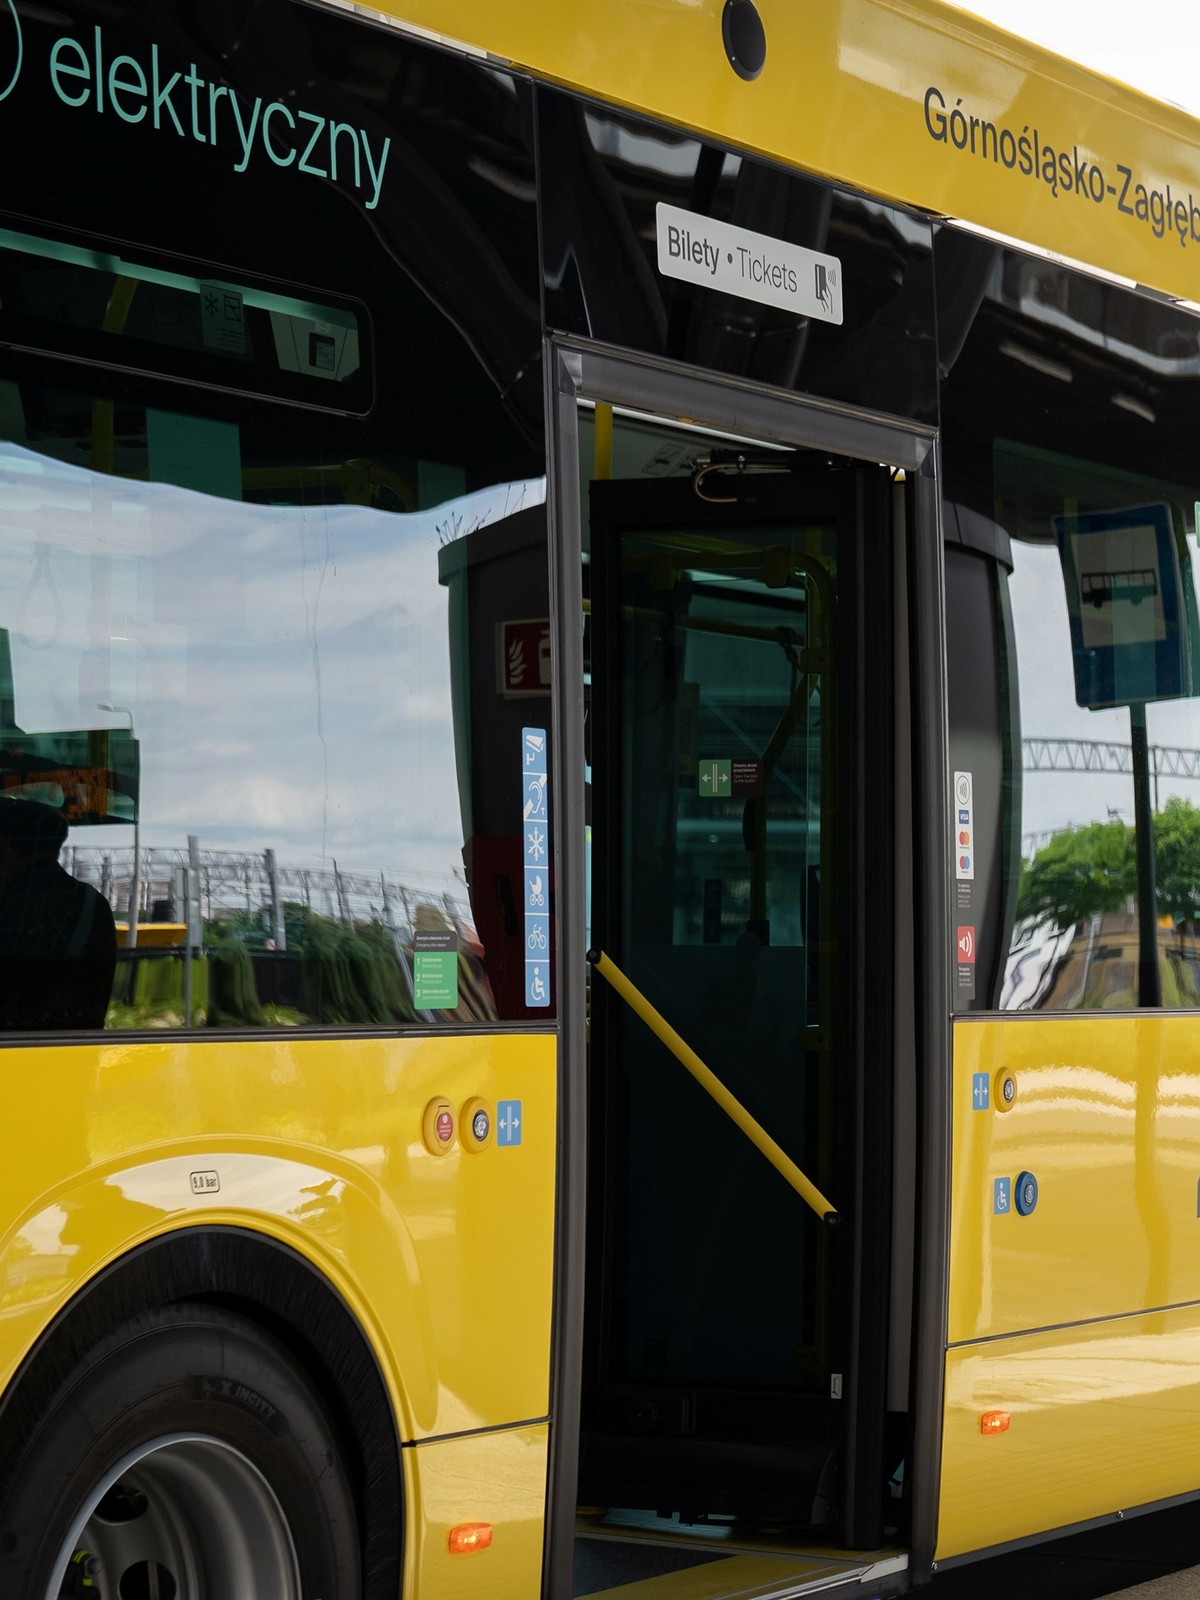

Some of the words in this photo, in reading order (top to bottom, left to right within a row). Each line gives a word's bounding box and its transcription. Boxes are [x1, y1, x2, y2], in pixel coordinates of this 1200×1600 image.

[50, 26, 391, 209] elektryczny
[668, 225, 720, 276] Bilety
[736, 246, 798, 293] Tickets
